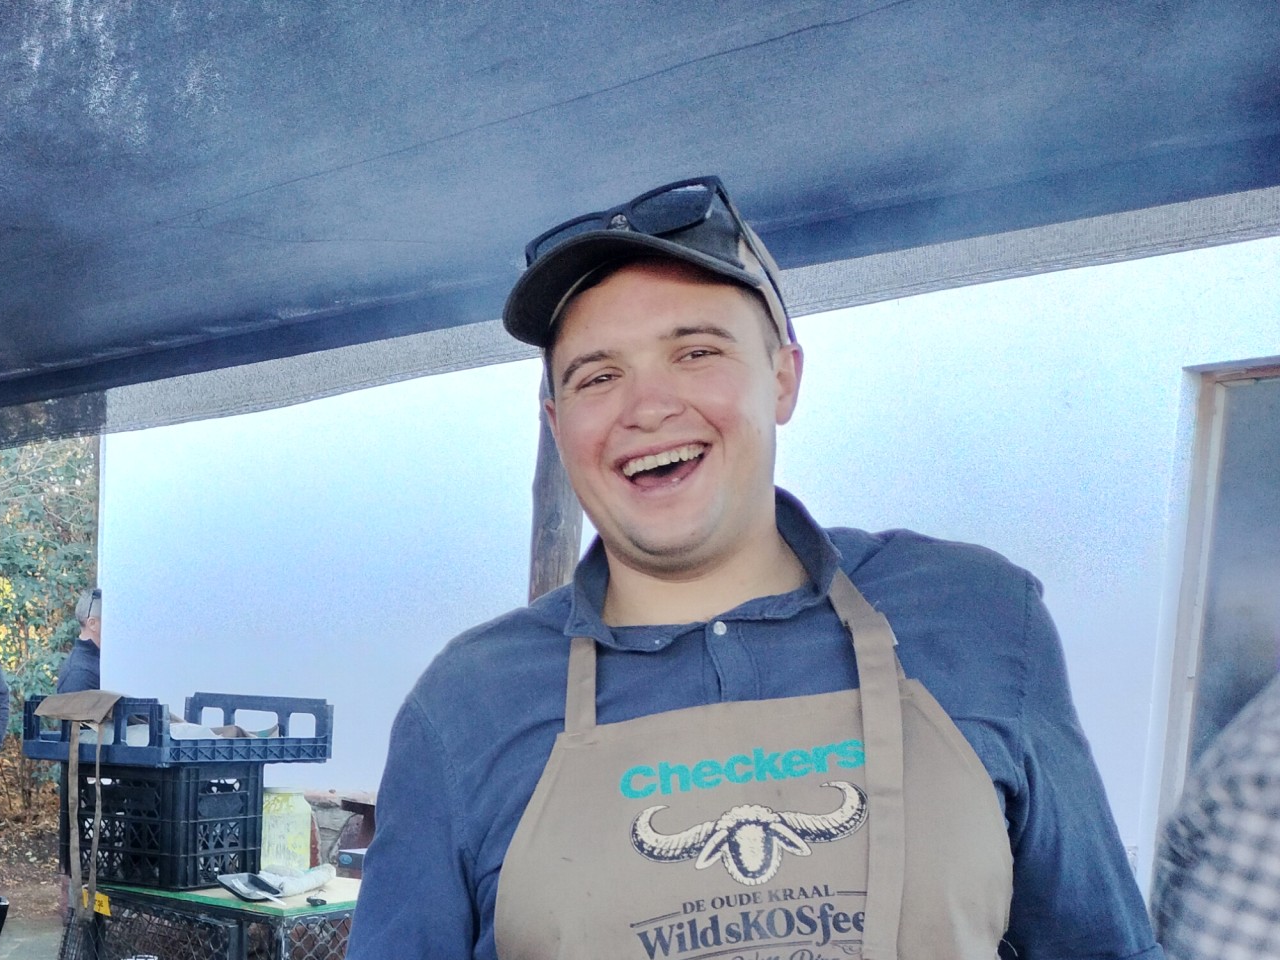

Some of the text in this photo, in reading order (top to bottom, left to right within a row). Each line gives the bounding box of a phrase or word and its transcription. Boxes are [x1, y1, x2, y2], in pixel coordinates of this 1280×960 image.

[620, 739, 866, 799] Checkers
[682, 884, 835, 915] DE OUDE KRAAL
